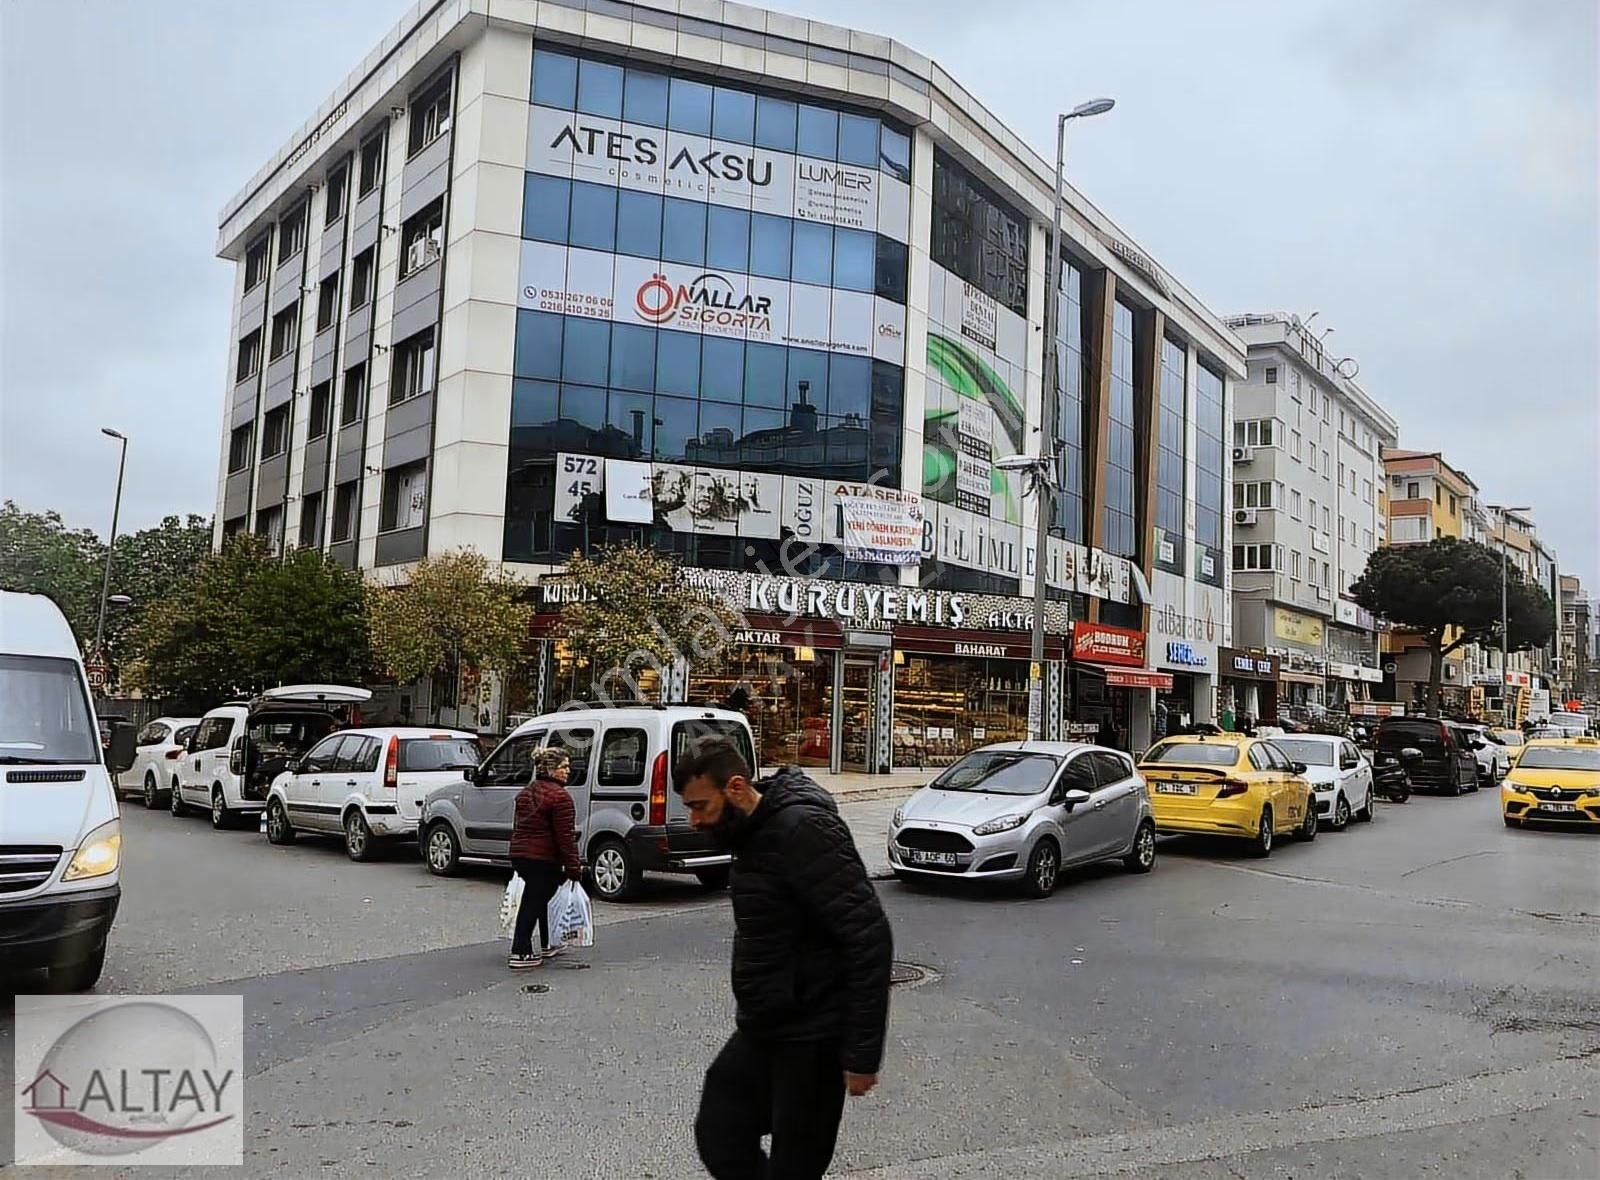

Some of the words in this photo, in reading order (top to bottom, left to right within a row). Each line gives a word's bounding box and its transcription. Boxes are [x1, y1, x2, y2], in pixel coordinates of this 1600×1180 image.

[669, 146, 772, 187] AKSU
[799, 163, 872, 192] LUMIER
[608, 167, 716, 194] cosmetics
[541, 289, 564, 301] 0531
[540, 300, 563, 312] 0216
[566, 304, 582, 314] 410
[564, 457, 597, 475] 572
[796, 483, 813, 537] OĞUZ
[750, 579, 964, 630] KURUYEMİŞ
[734, 630, 781, 645] AKTAR
[955, 643, 1007, 657] BAHARAT
